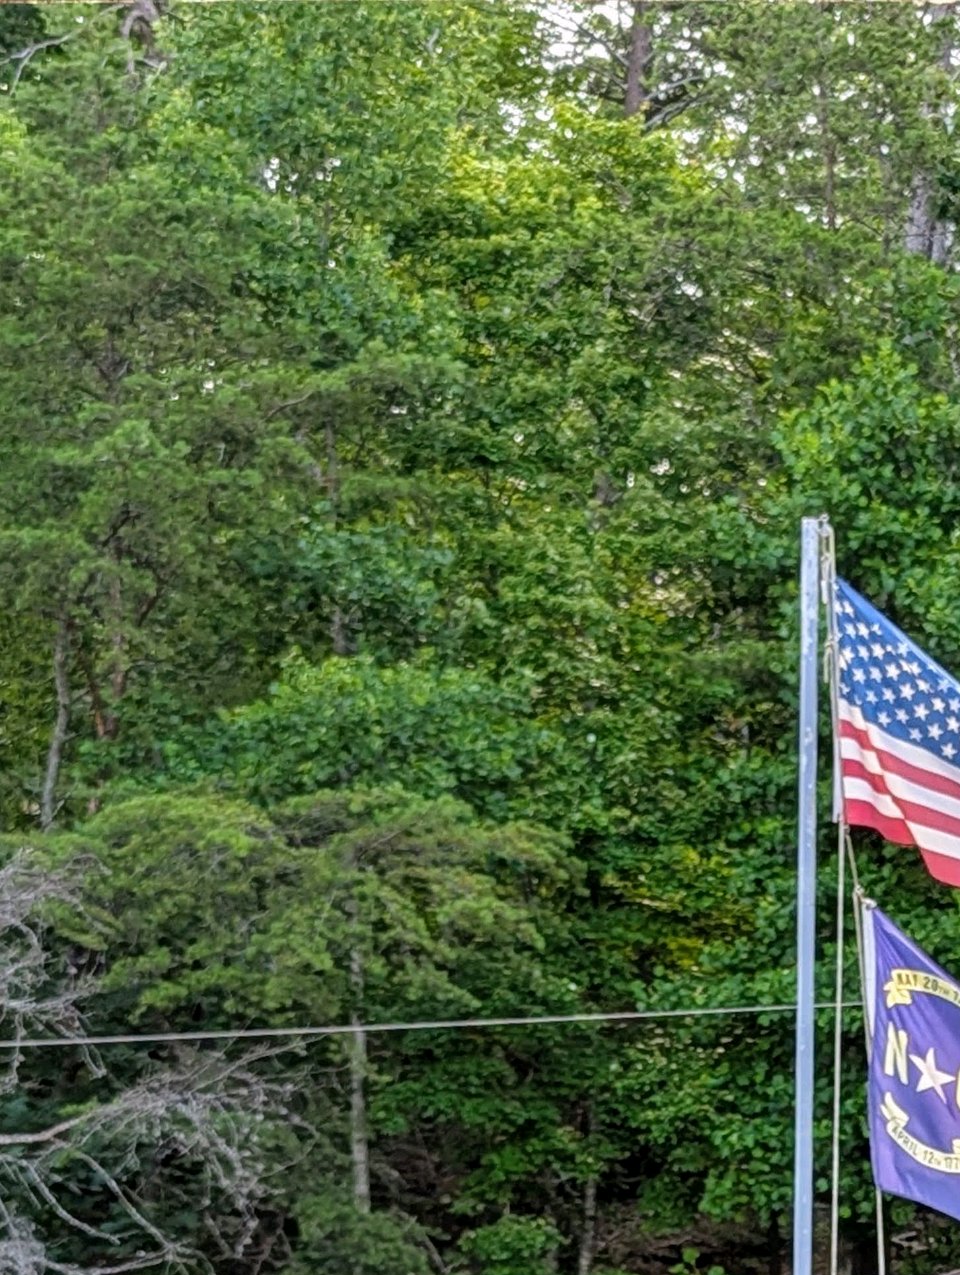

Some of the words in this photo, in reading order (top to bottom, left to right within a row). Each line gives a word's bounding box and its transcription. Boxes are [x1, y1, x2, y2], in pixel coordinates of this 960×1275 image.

[896, 973, 918, 986] MAY
[884, 1020, 909, 1086] N
[891, 1125, 917, 1156] APRIL
